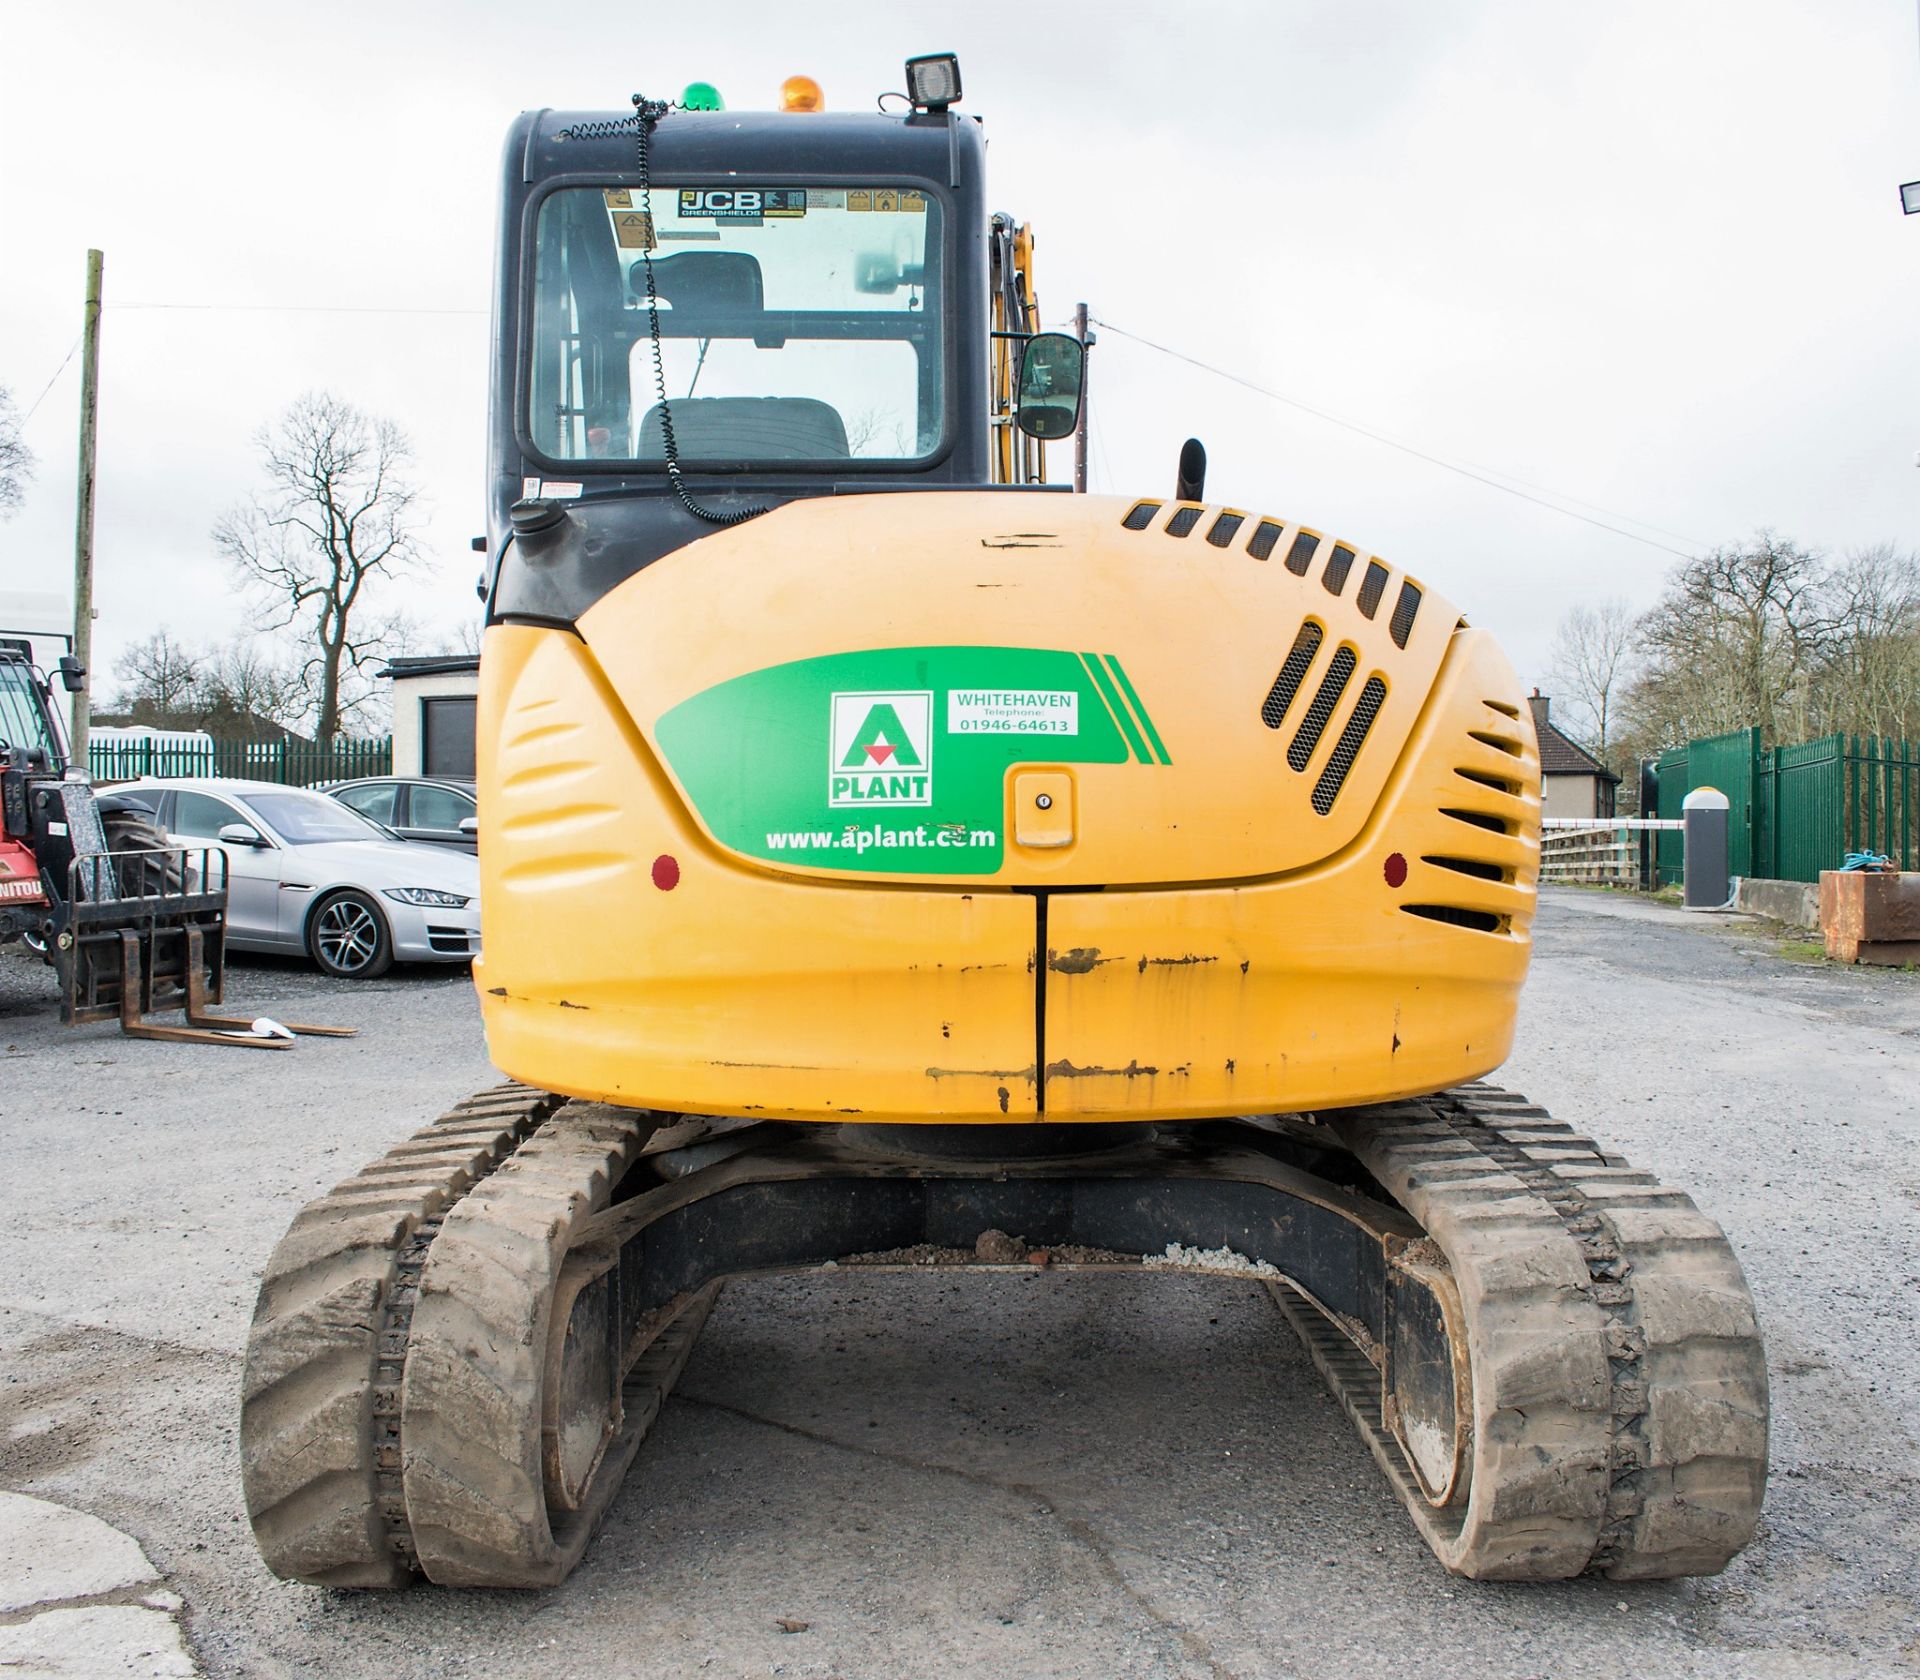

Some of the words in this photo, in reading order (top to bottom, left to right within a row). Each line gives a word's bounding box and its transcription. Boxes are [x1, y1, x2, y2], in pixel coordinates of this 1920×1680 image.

[682, 191, 761, 210] JCB
[957, 693, 1071, 708] WHITEHAVEN
[984, 708, 1044, 716] Telephone:
[960, 720, 1068, 732] 01946-64613
[841, 704, 922, 766] A
[832, 776, 928, 799] PLANT
